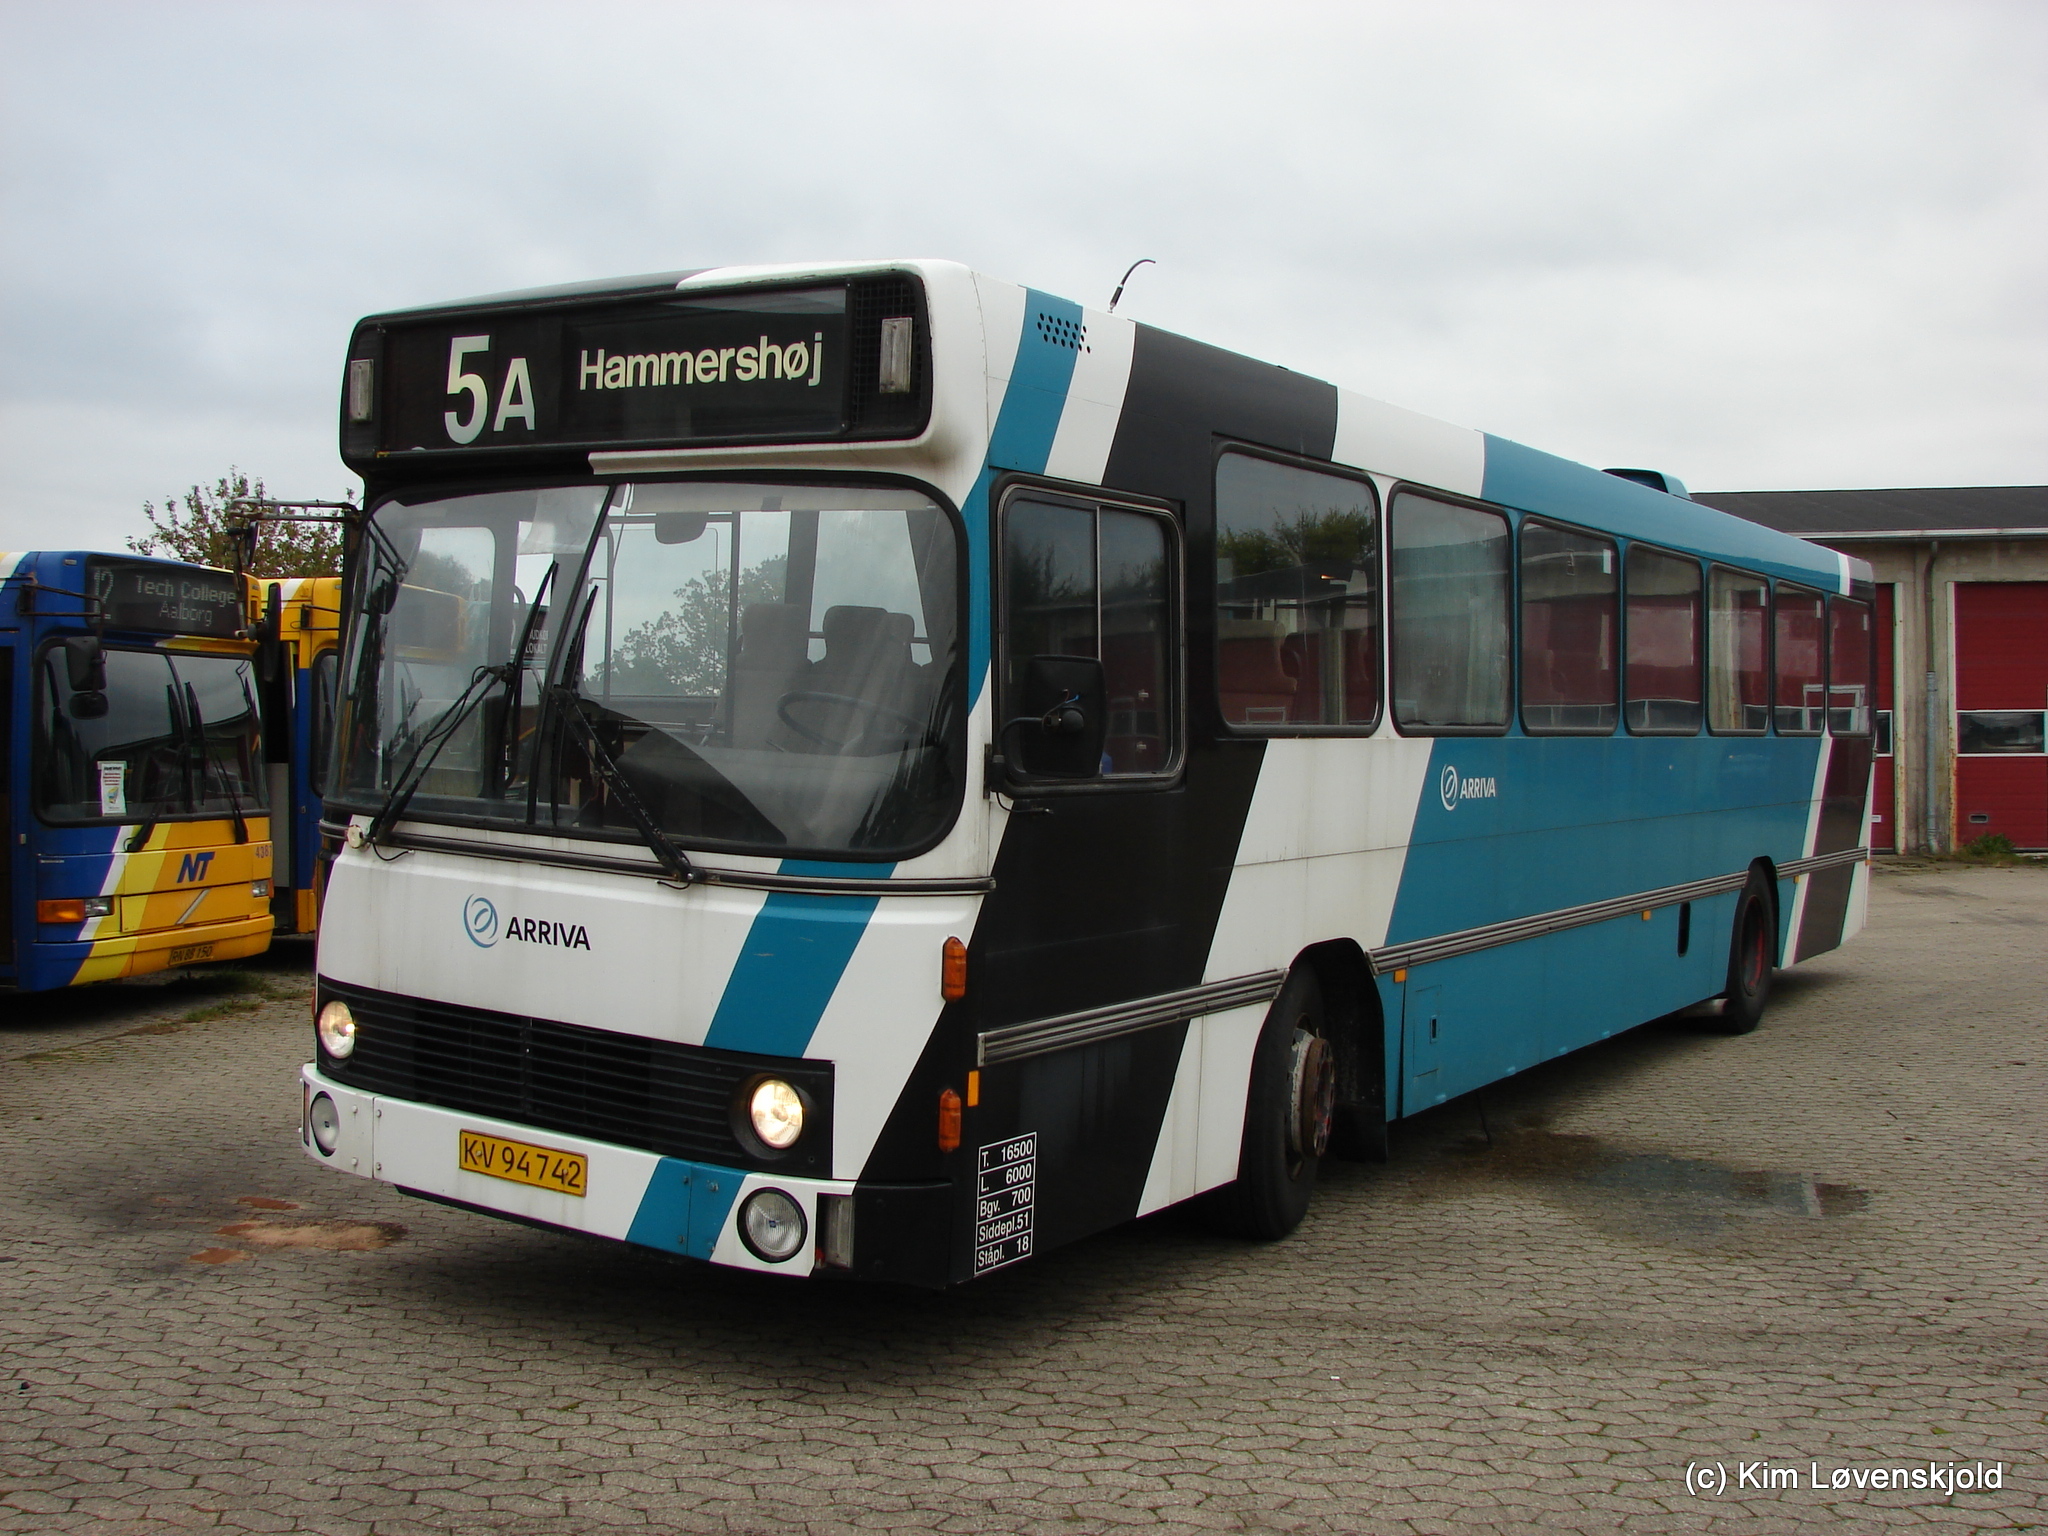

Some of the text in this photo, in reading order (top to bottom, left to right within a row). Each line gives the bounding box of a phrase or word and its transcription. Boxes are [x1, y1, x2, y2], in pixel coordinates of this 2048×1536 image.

[579, 332, 823, 391] Hammershøj
[136, 574, 237, 608] Tech College
[159, 600, 213, 627] Aalborg
[1459, 777, 1496, 799] ARRIVA
[177, 851, 215, 883] NT
[506, 916, 591, 950] ARRIVA
[464, 1138, 495, 1168] KV
[1001, 1139, 1034, 1162] 16500
[1006, 1163, 1032, 1184] 6000
[980, 1186, 1031, 1218] Bgv. 700
[978, 1235, 1029, 1267] Ståpl. 18
